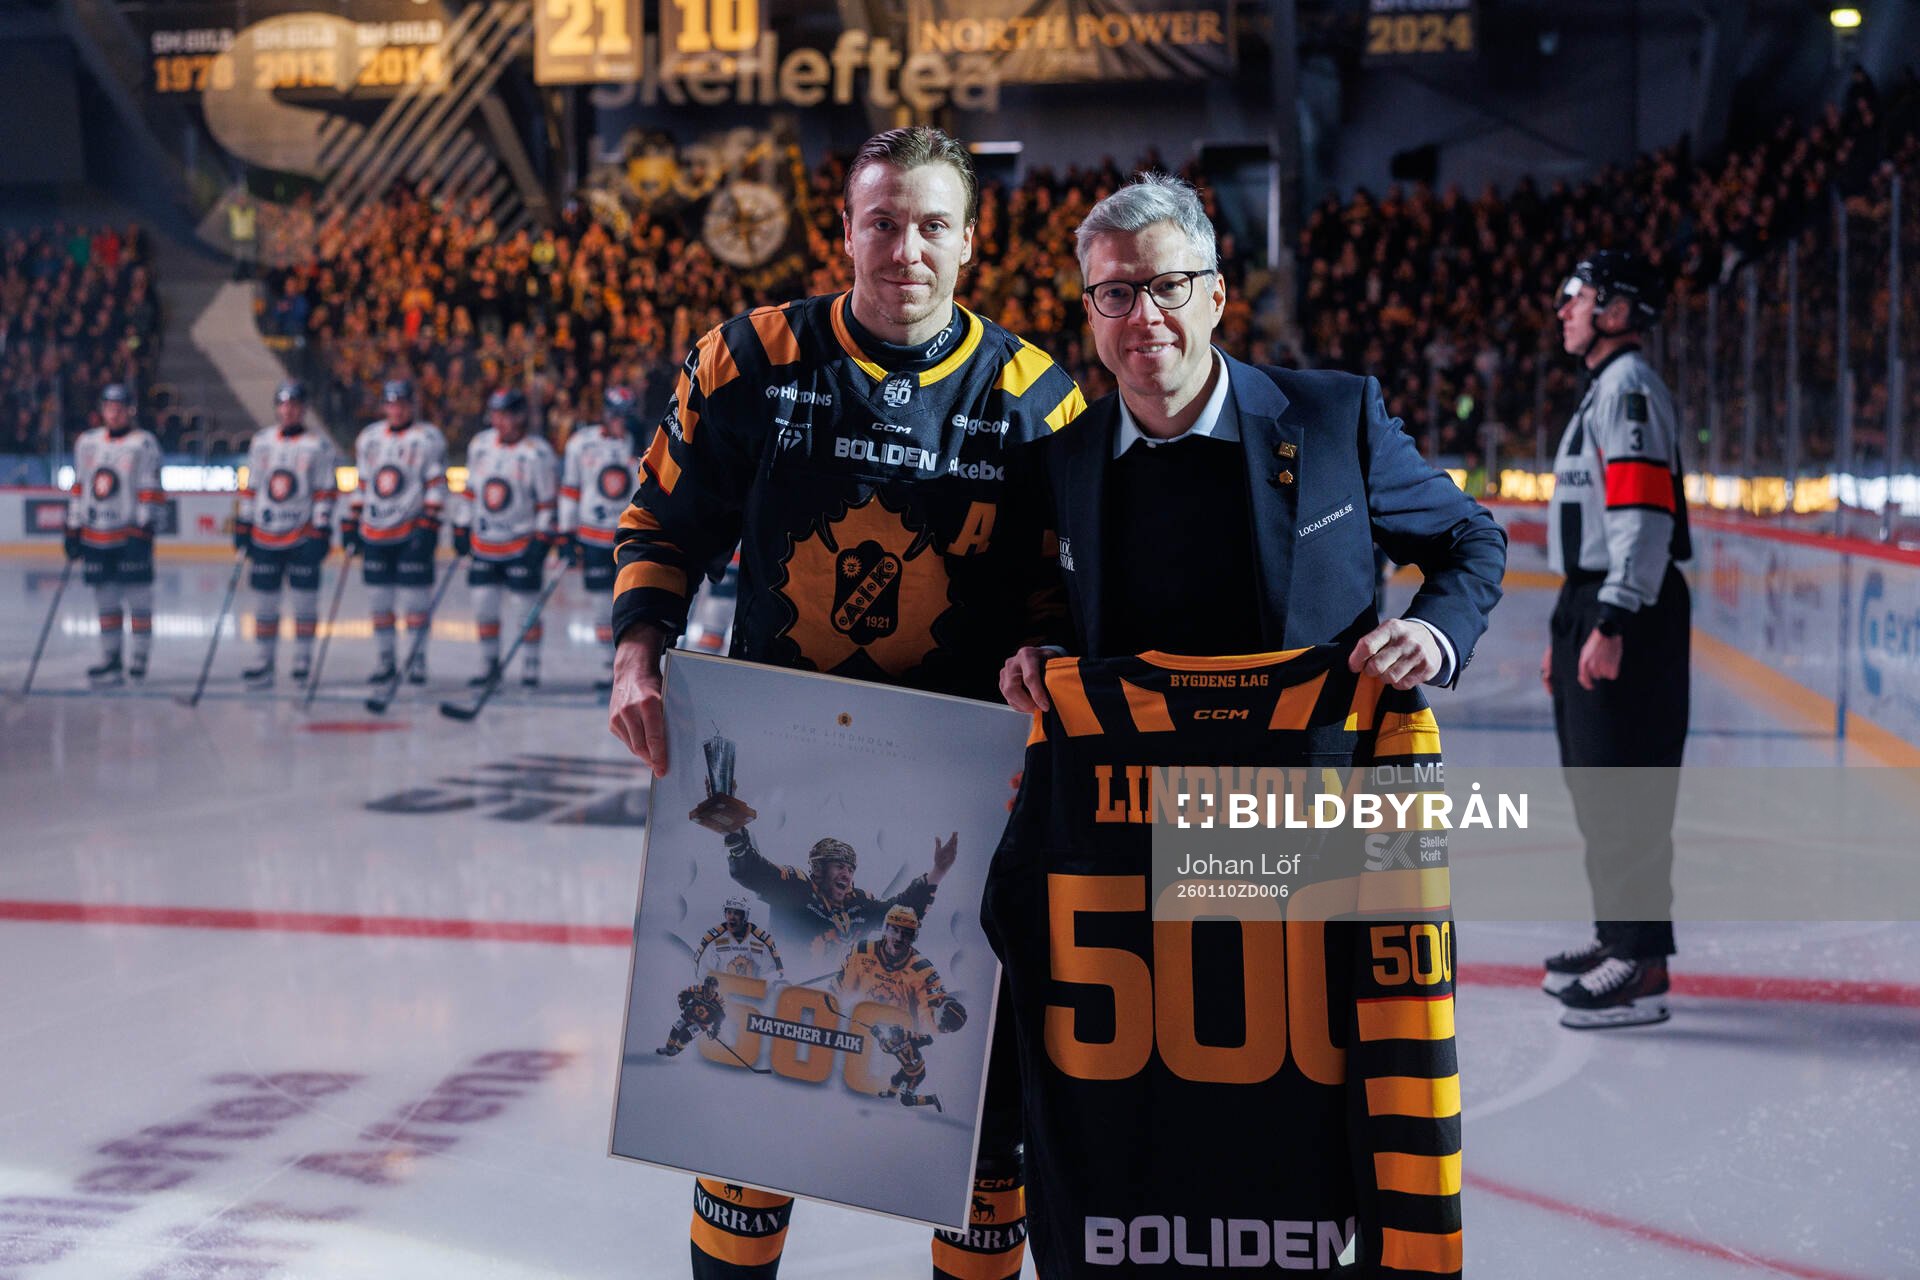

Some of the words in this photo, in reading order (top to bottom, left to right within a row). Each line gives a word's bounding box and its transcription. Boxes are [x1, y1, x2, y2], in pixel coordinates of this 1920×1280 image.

[546, 0, 633, 56] 21
[671, 0, 761, 53] 10
[920, 15, 1068, 53] NORTH
[1076, 10, 1226, 47] POWER
[1367, 14, 1474, 54] 2024
[883, 386, 912, 405] 50
[871, 422, 912, 435] CCM
[1630, 428, 1644, 452] 3
[834, 436, 938, 473] BOLIDEN
[946, 500, 997, 557] A
[1298, 504, 1353, 537] LOCALSTORE.SE
[865, 615, 890, 629] 1921
[1170, 674, 1237, 688] BYGDENS
[1240, 674, 1269, 688] LAG
[1193, 708, 1250, 720] CCM
[1094, 764, 1365, 825] LINDHOLM
[1420, 849, 1441, 862] Kraft
[1369, 920, 1452, 986] 500
[749, 1015, 824, 1044] MATCHER
[824, 1030, 832, 1046] I
[834, 1033, 862, 1052] AIK
[695, 1186, 780, 1233] NORRAN
[1084, 1214, 1356, 1270] BOLIDEN
